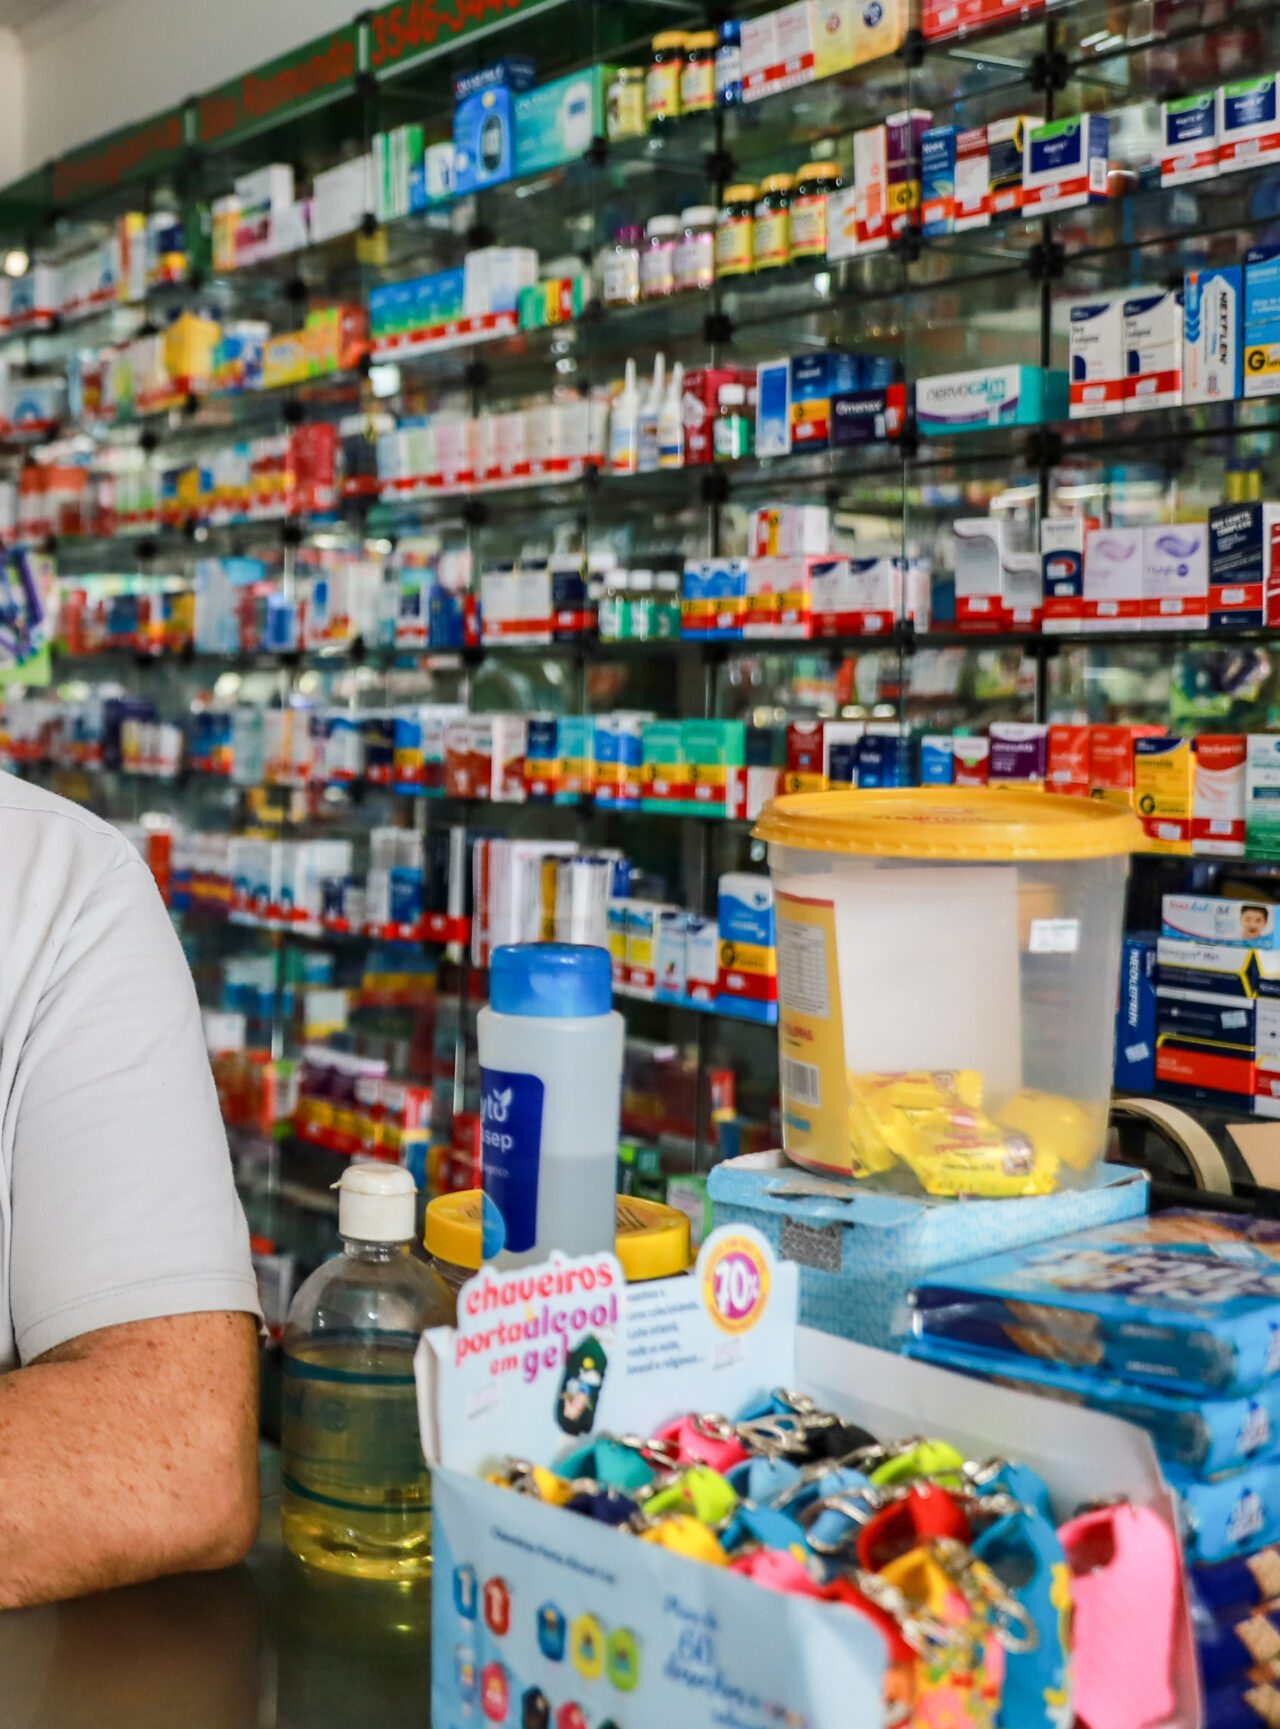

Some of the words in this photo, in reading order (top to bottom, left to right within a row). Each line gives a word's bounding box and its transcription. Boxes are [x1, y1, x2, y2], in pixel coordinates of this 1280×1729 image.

[1247, 350, 1266, 371] G
[466, 1260, 614, 1316] chaveiros
[489, 1354, 518, 1375] em
[523, 1332, 570, 1384] gel
